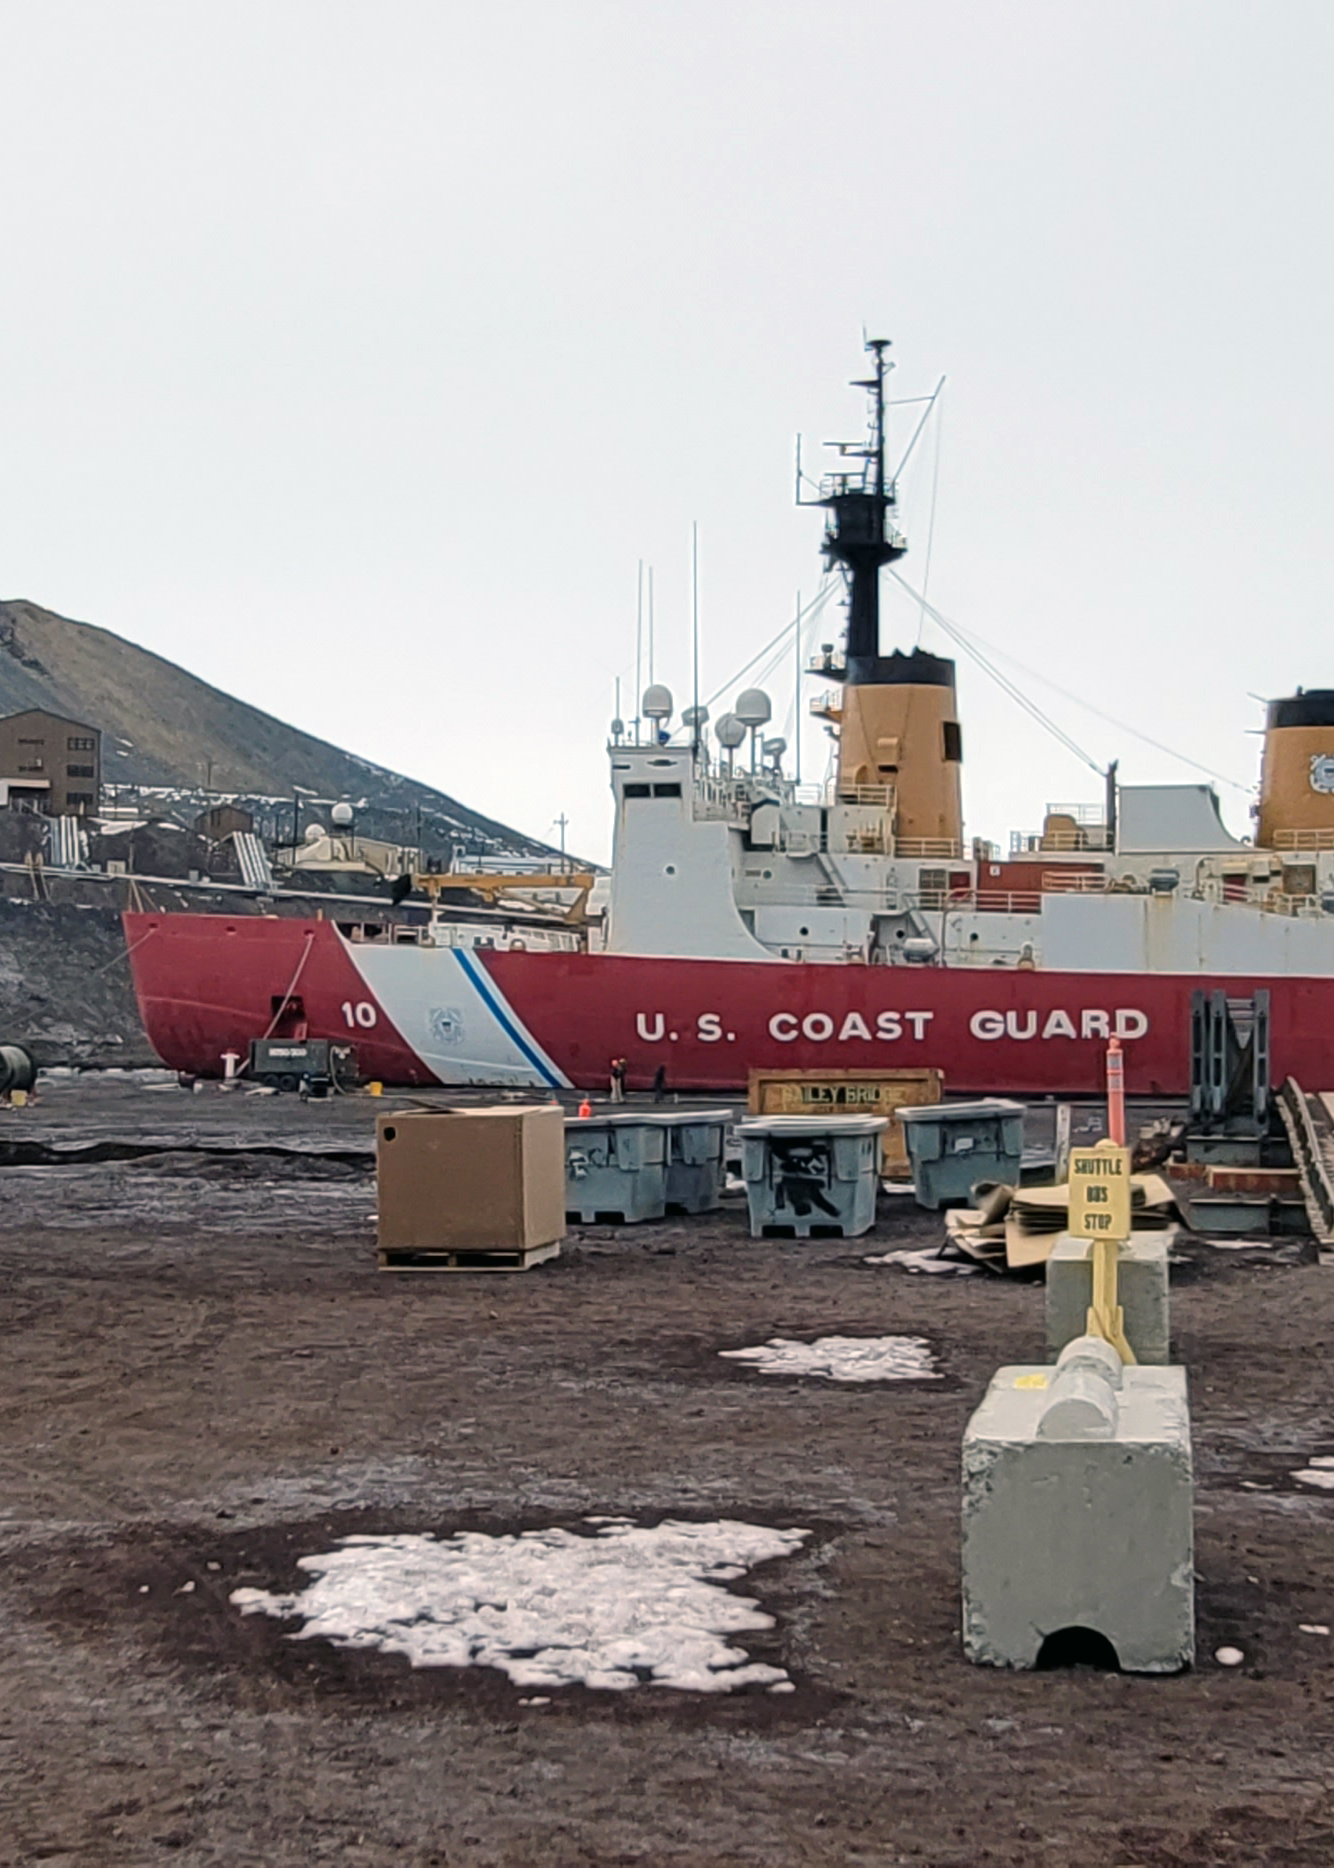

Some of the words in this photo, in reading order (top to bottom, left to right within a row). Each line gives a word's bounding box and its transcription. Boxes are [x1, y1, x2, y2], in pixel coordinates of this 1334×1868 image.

[342, 1001, 376, 1028] 10
[637, 1013, 678, 1041] U.
[698, 1013, 735, 1041] S.
[769, 1011, 934, 1041] COAST
[970, 1009, 1148, 1040] GUARD
[1074, 1158, 1123, 1176] SHUTTLE
[1084, 1213, 1112, 1230] STOP
